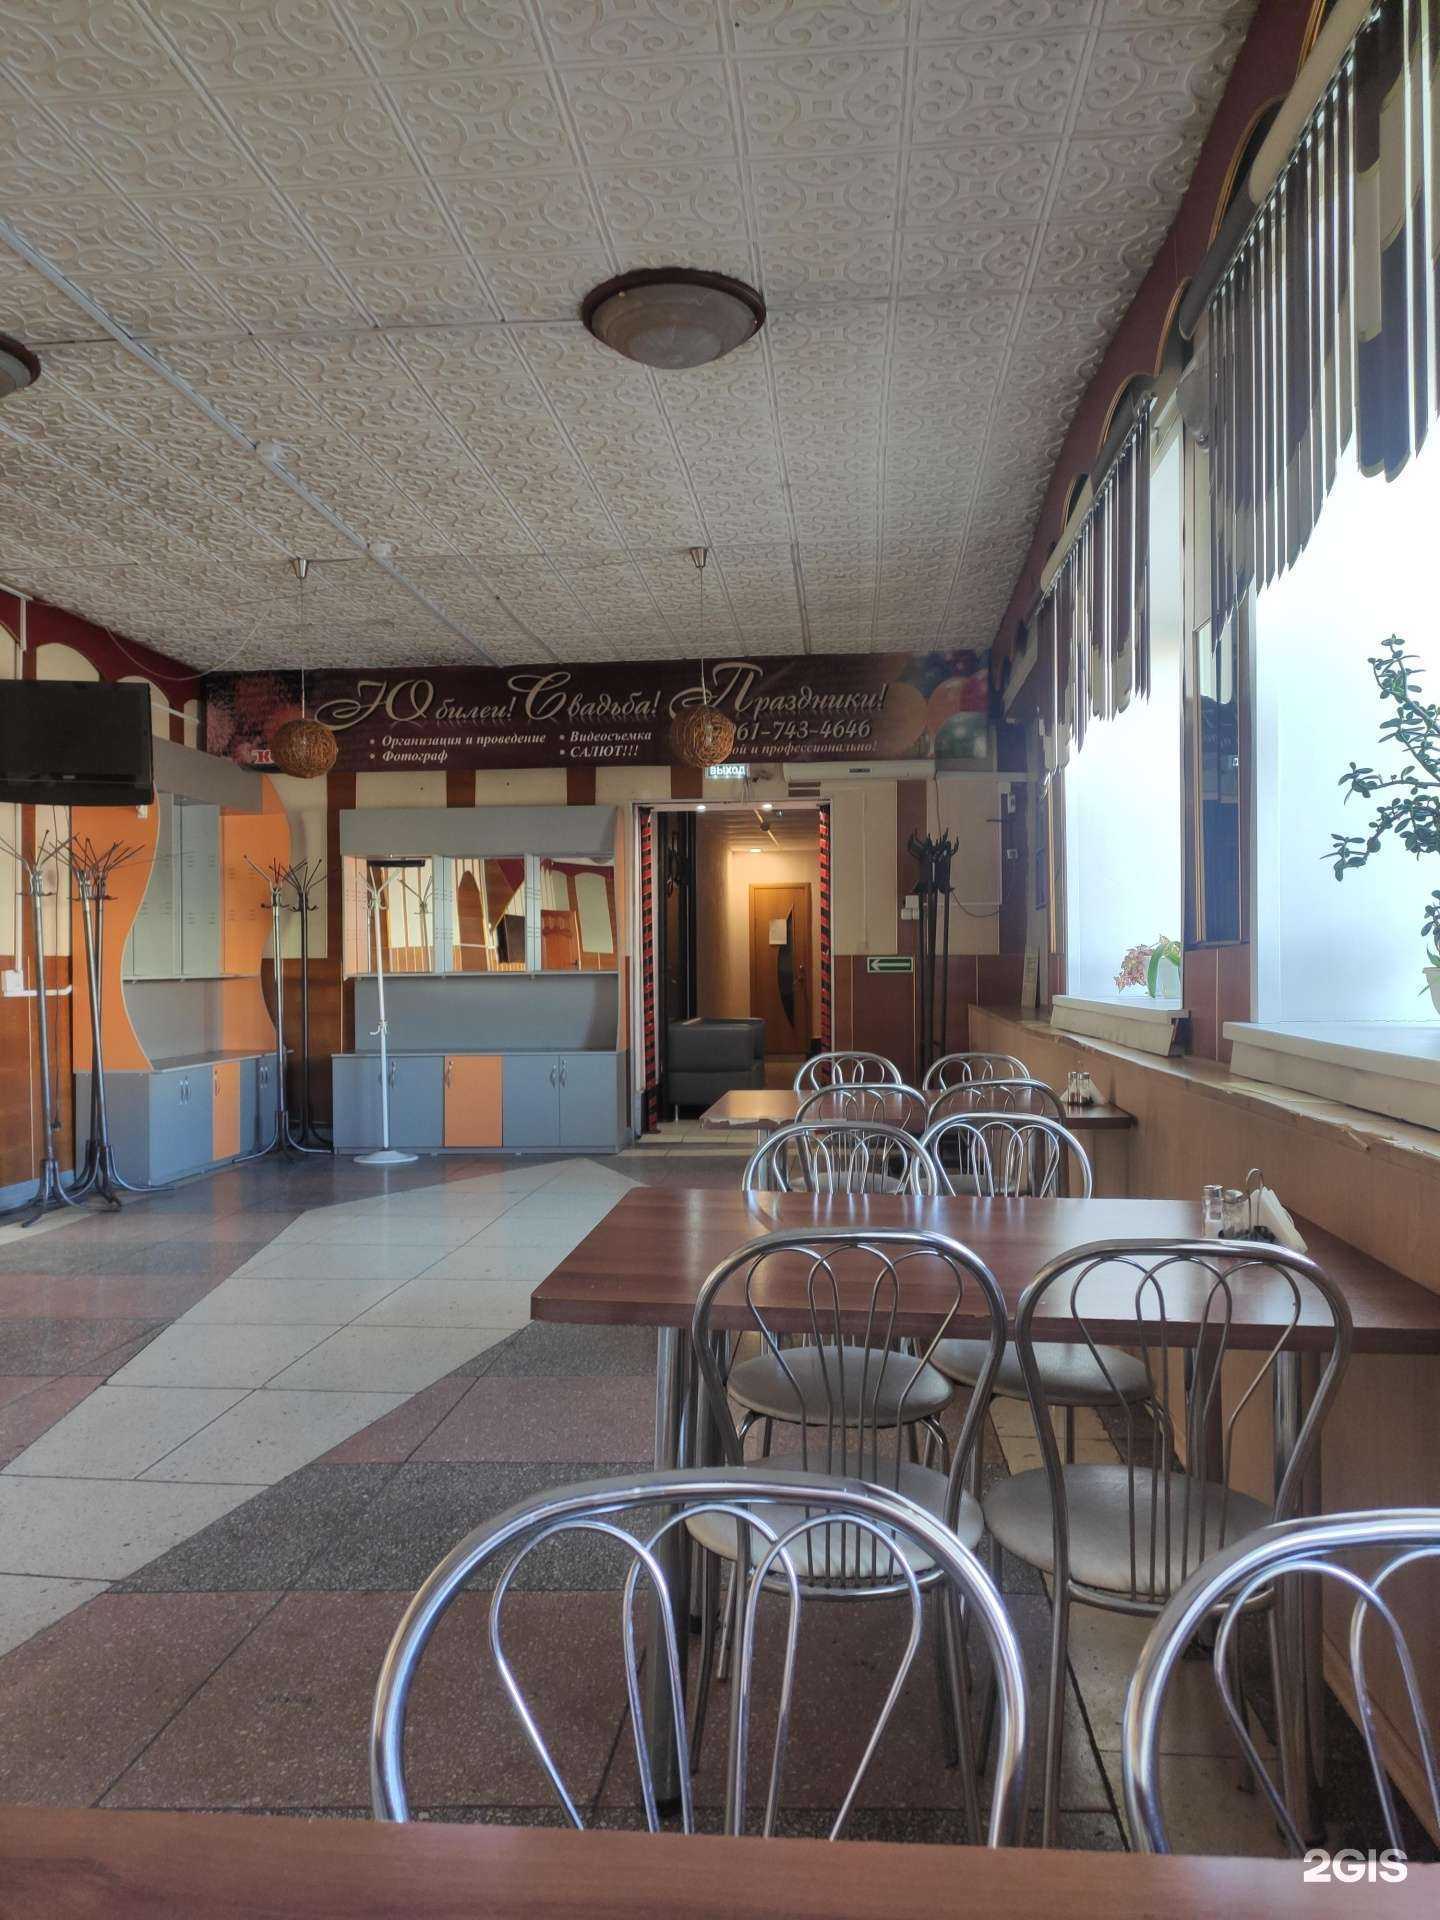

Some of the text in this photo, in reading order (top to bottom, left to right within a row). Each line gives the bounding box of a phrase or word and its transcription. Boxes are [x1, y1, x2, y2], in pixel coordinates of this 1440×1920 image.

[507, 671, 661, 720] Свадьба!
[669, 661, 888, 720] Праздники!
[569, 730, 652, 743] Видеосъемка
[732, 719, 871, 740] 61-743-4646
[382, 733, 547, 749] Организация и проведение
[751, 744, 759, 755] и
[762, 741, 878, 756] профессионально!
[382, 750, 448, 764] Фотограф
[570, 745, 639, 758] САЛЮТ!!!
